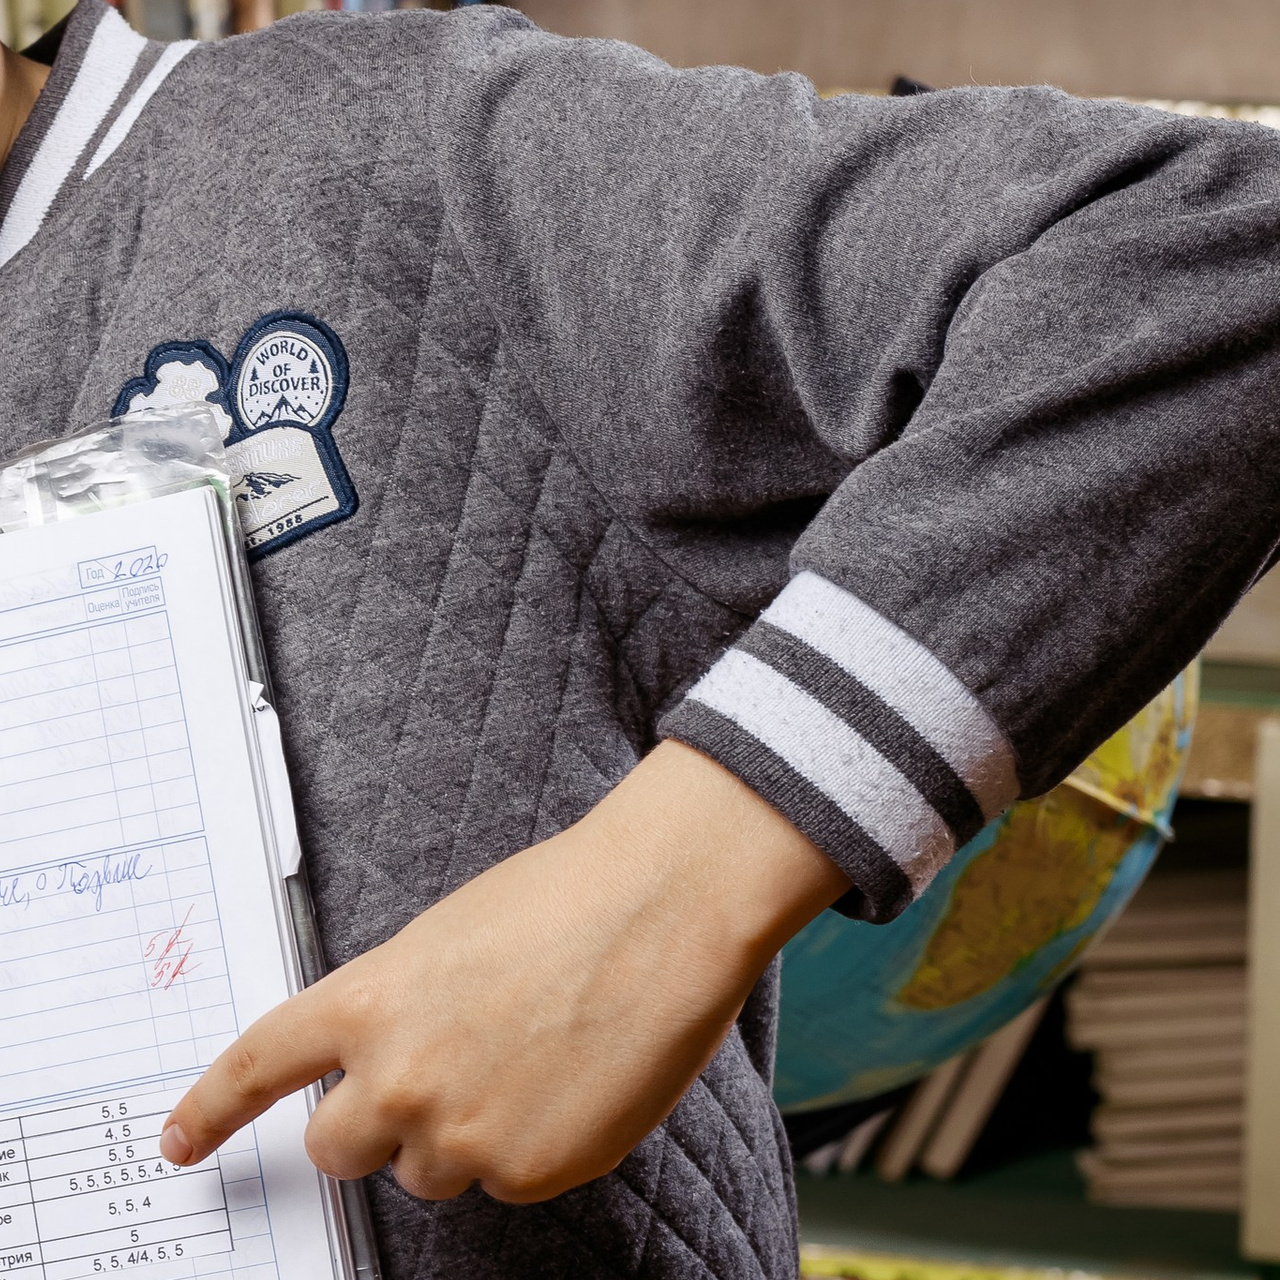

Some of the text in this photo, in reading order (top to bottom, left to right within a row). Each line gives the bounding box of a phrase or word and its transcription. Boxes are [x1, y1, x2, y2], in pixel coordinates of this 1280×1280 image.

[256, 340, 309, 366] WORLD
[272, 363, 292, 378] OF
[249, 376, 320, 397] DISCOVER
[268, 514, 303, 535] 1988
[85, 567, 105, 582] Год
[121, 582, 160, 600] Подпись
[87, 598, 120, 614] Оценка
[124, 592, 161, 611] учителя
[102, 1102, 127, 1119] 5, 5
[105, 1124, 131, 1140] 4, 5
[108, 1145, 134, 1162] 5, 5
[69, 1178, 82, 1191] 5,
[87, 1175, 99, 1188] 5,
[103, 1172, 116, 1185] 5,
[120, 1168, 133, 1181] 5,
[138, 1165, 151, 1178] 5,
[155, 1162, 168, 1175] 4,
[108, 1196, 151, 1215] 5, 5, 4
[130, 1229, 139, 1242] 5
[93, 1259, 106, 1272] 5,
[110, 1256, 123, 1269] 5,
[157, 1247, 170, 1260] 5,
[175, 1244, 183, 1257] 5
